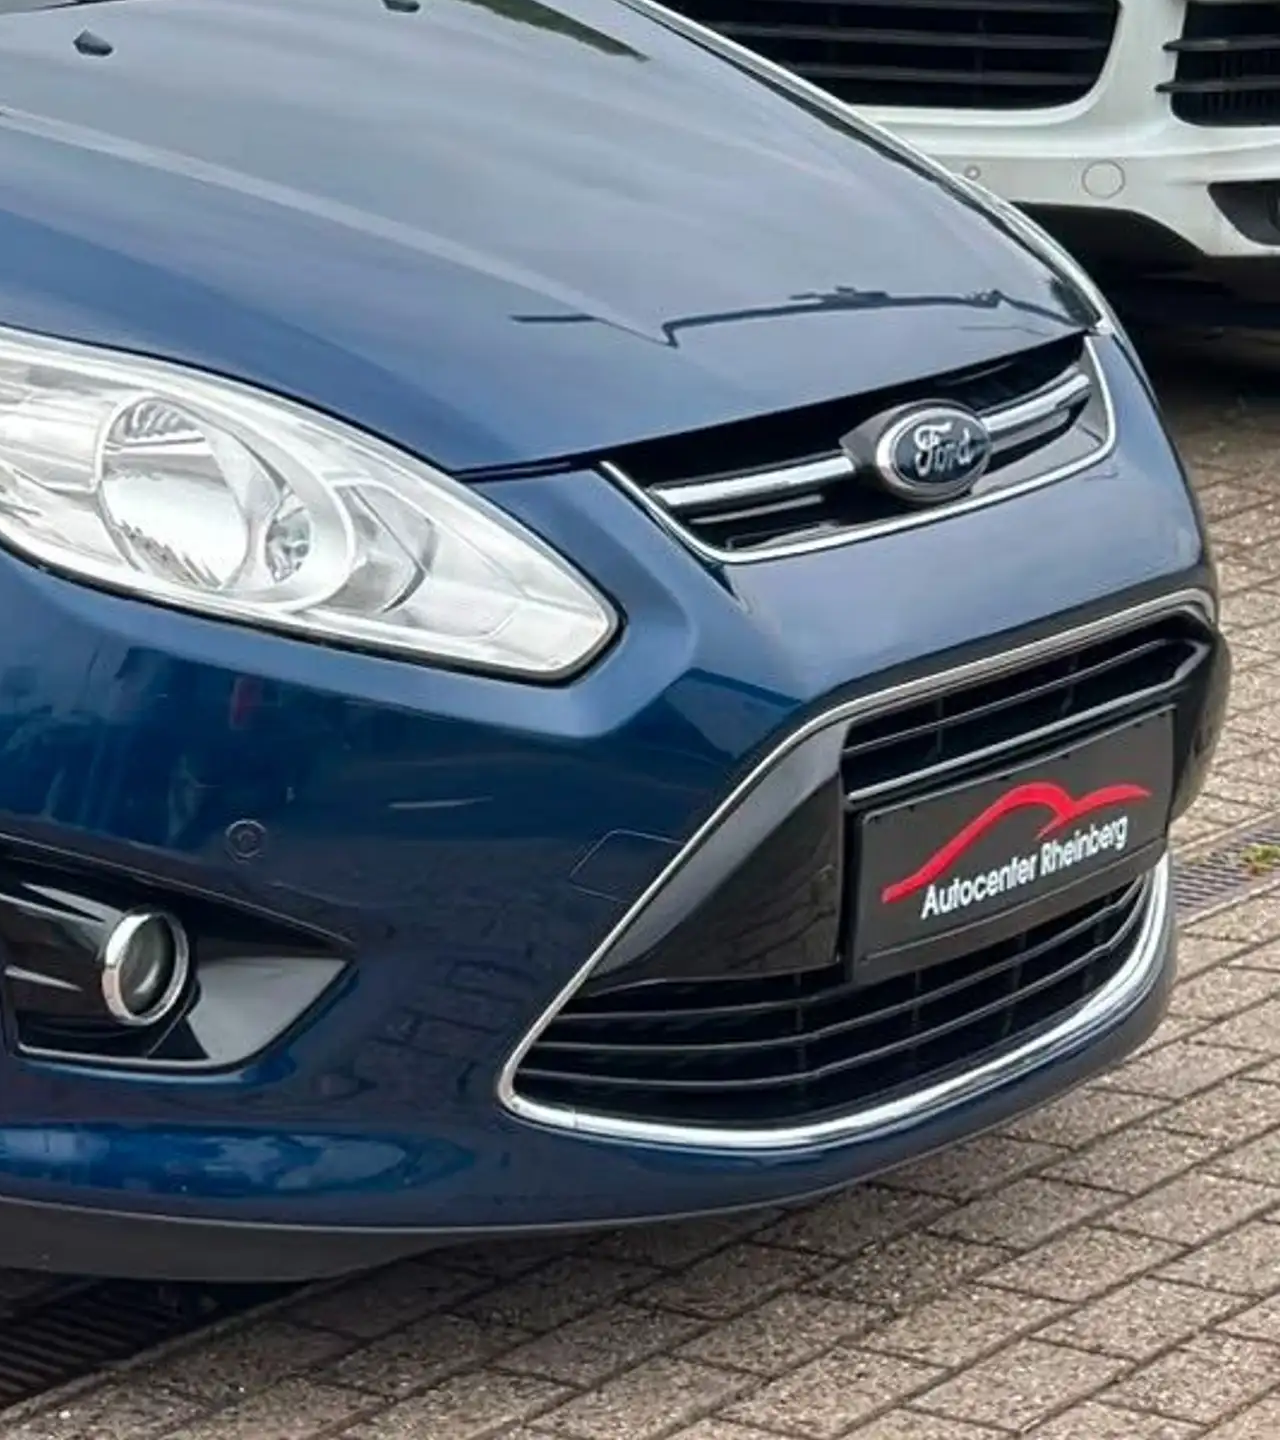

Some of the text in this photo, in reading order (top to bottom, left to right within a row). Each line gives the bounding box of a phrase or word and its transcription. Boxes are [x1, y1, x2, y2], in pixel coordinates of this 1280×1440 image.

[913, 421, 985, 478] Ford
[920, 815, 1129, 920] Autocenter Rheinberg
